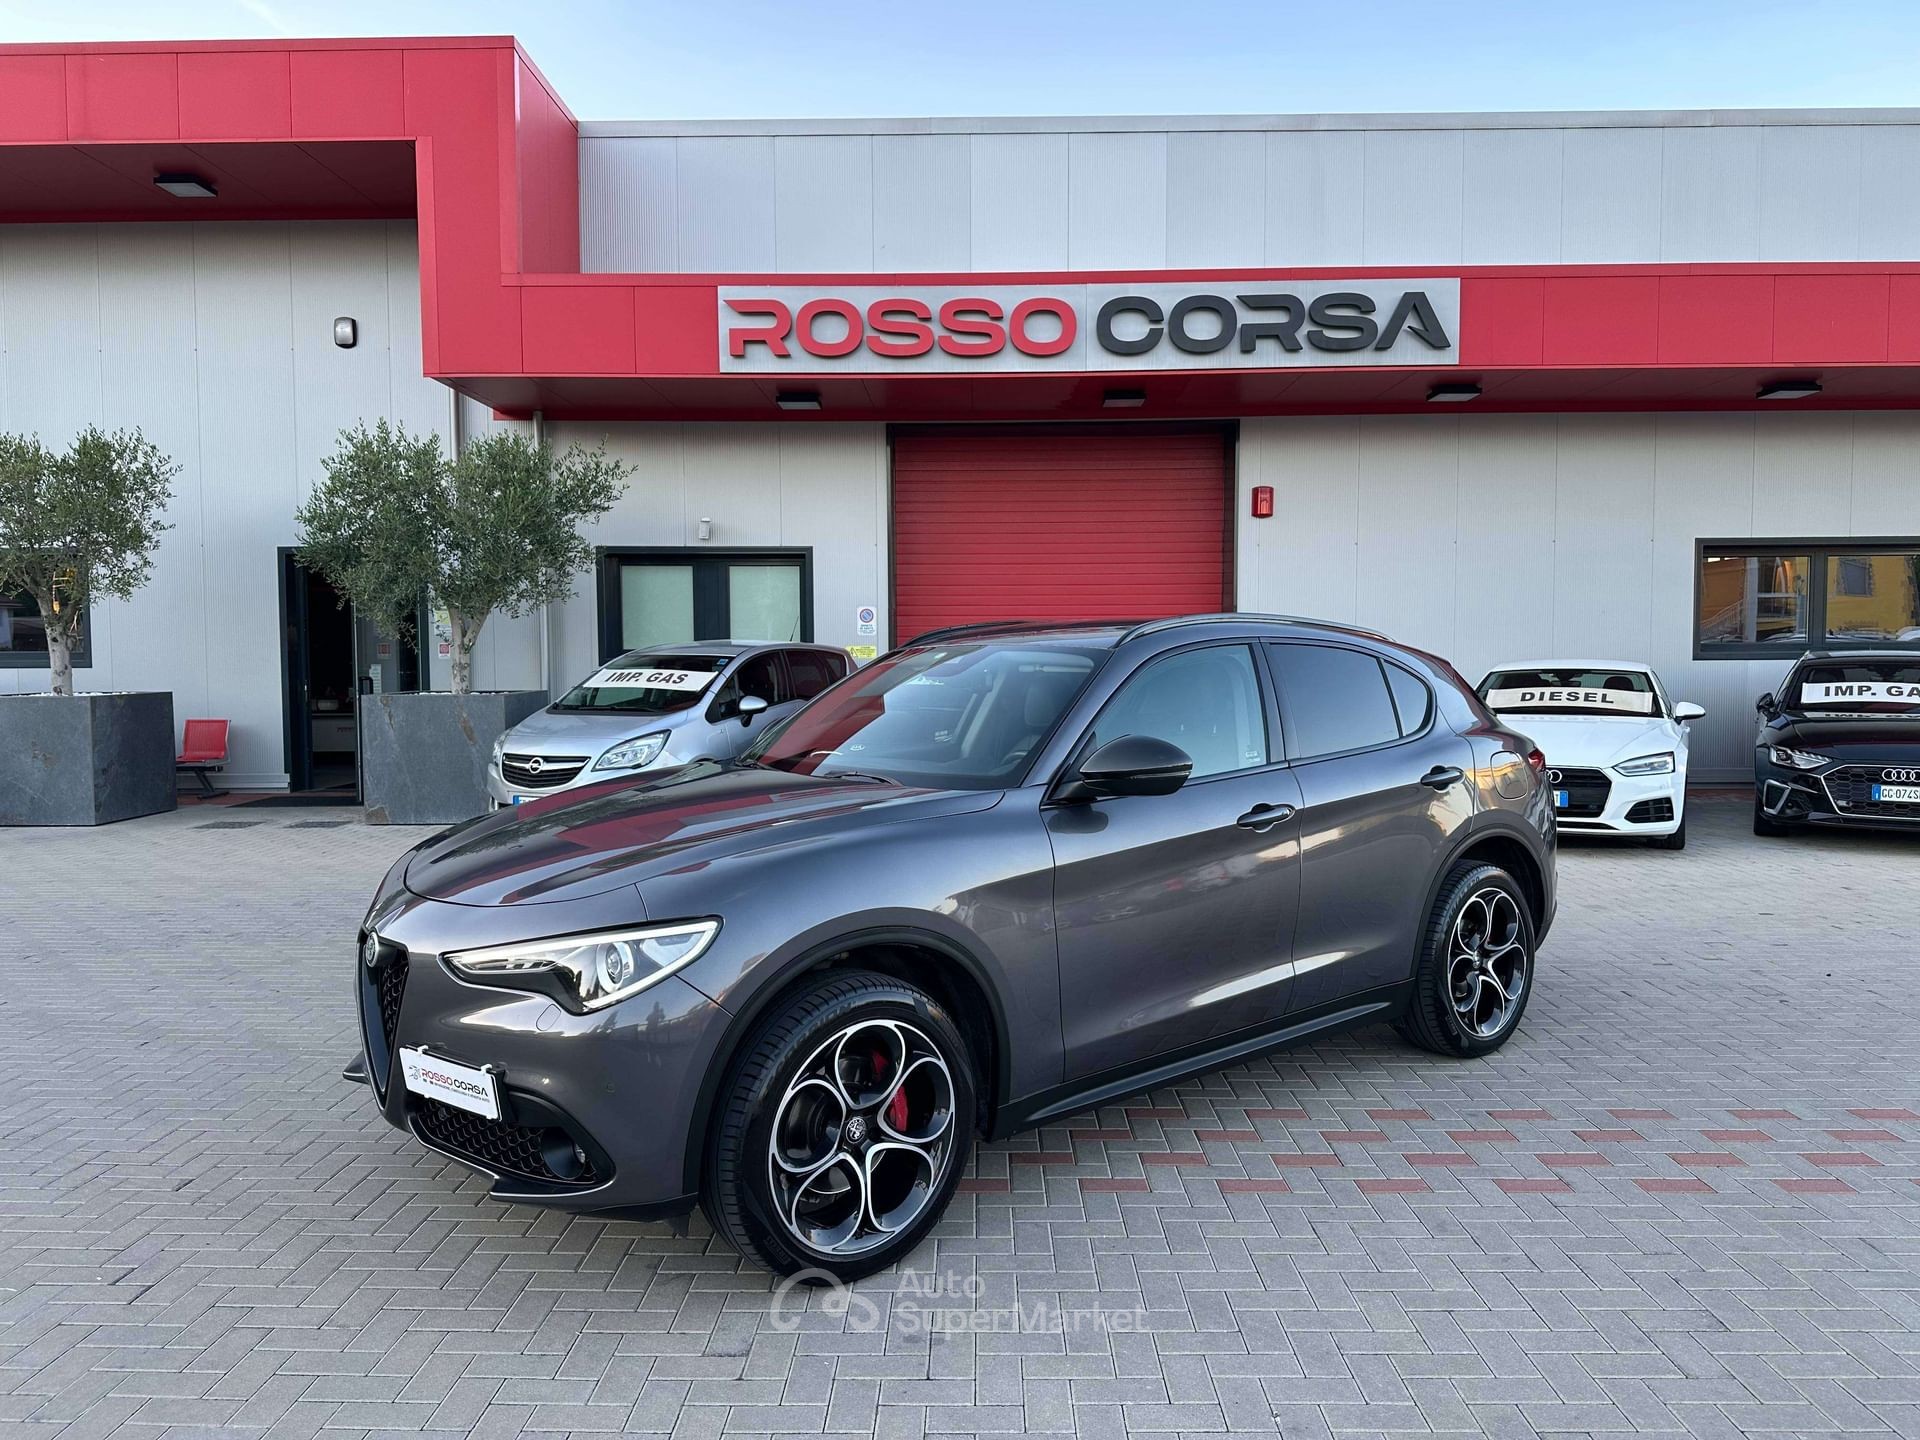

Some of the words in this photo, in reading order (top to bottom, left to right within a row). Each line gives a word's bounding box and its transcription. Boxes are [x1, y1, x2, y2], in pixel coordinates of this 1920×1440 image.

[723, 298, 1077, 357] ROSSO
[1098, 292, 1452, 354] CORSA
[604, 672, 643, 682] IMP.
[646, 672, 689, 684] GAS
[1824, 685, 1877, 697] IMP.
[1520, 691, 1614, 704] DIESEL
